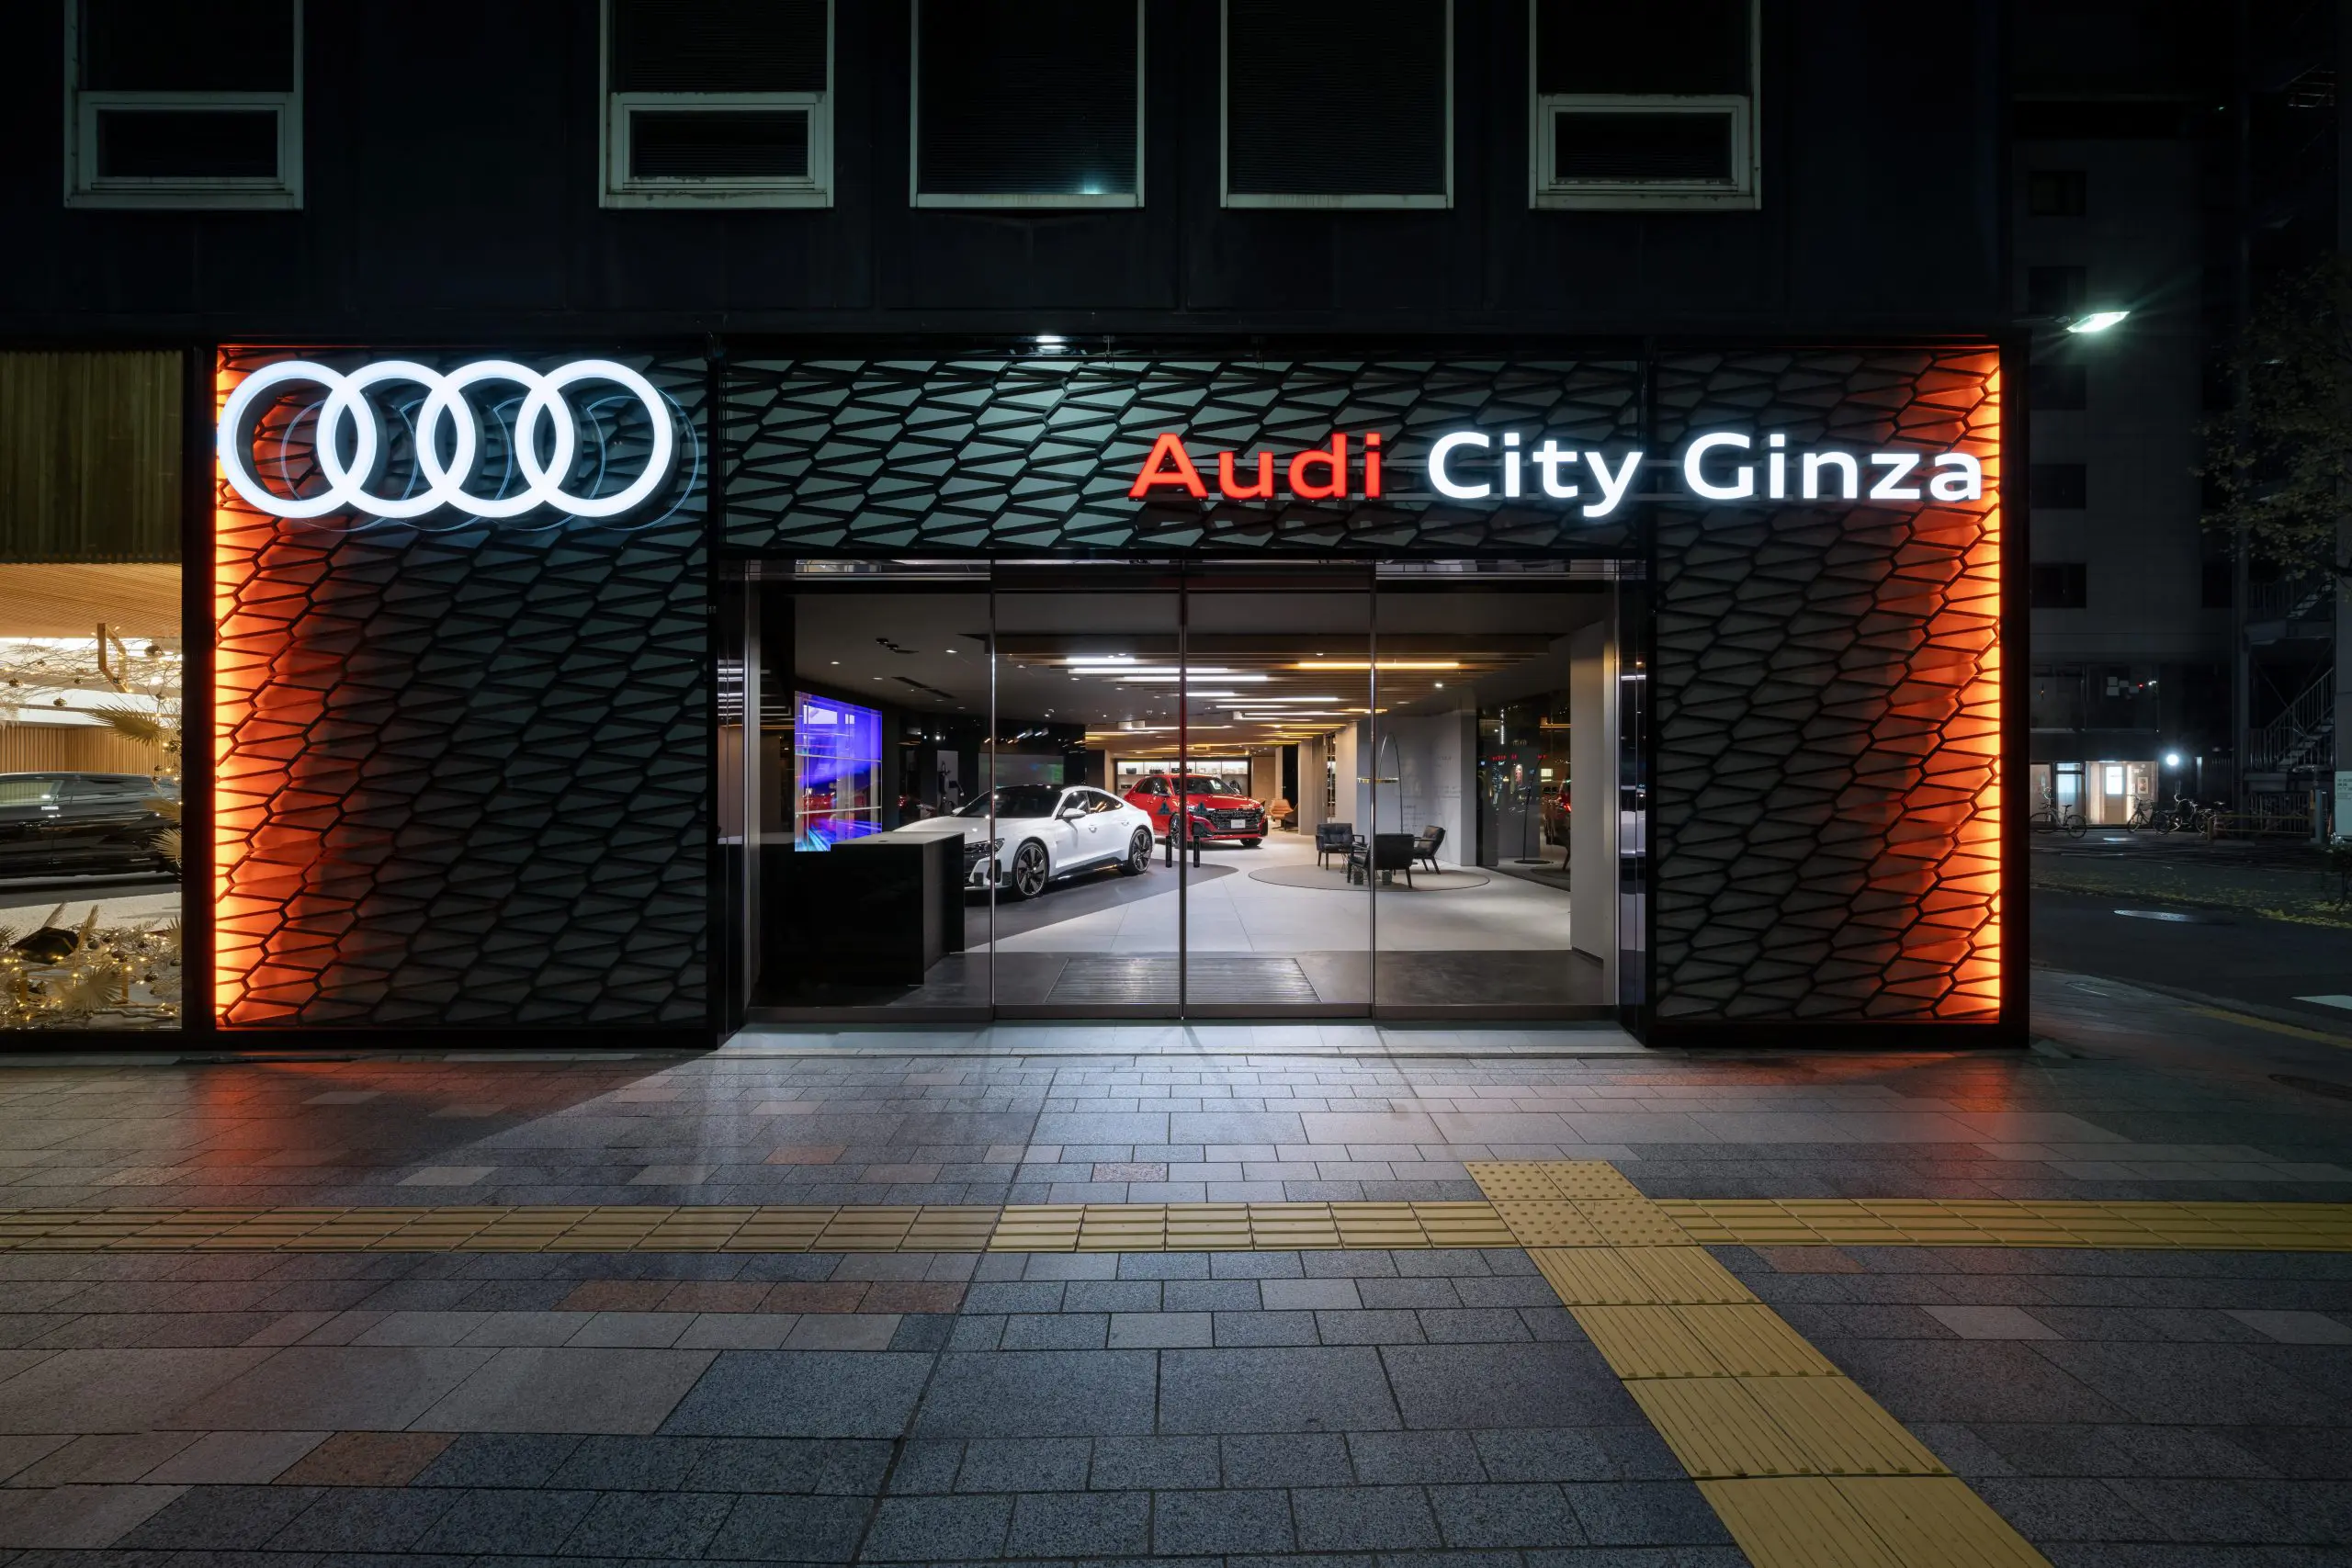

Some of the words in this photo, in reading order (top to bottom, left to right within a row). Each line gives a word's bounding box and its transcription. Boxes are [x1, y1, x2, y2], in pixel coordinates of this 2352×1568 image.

[1128, 433, 1382, 499] Audi
[1427, 431, 1643, 518] City
[1683, 432, 1982, 501] Ginza
